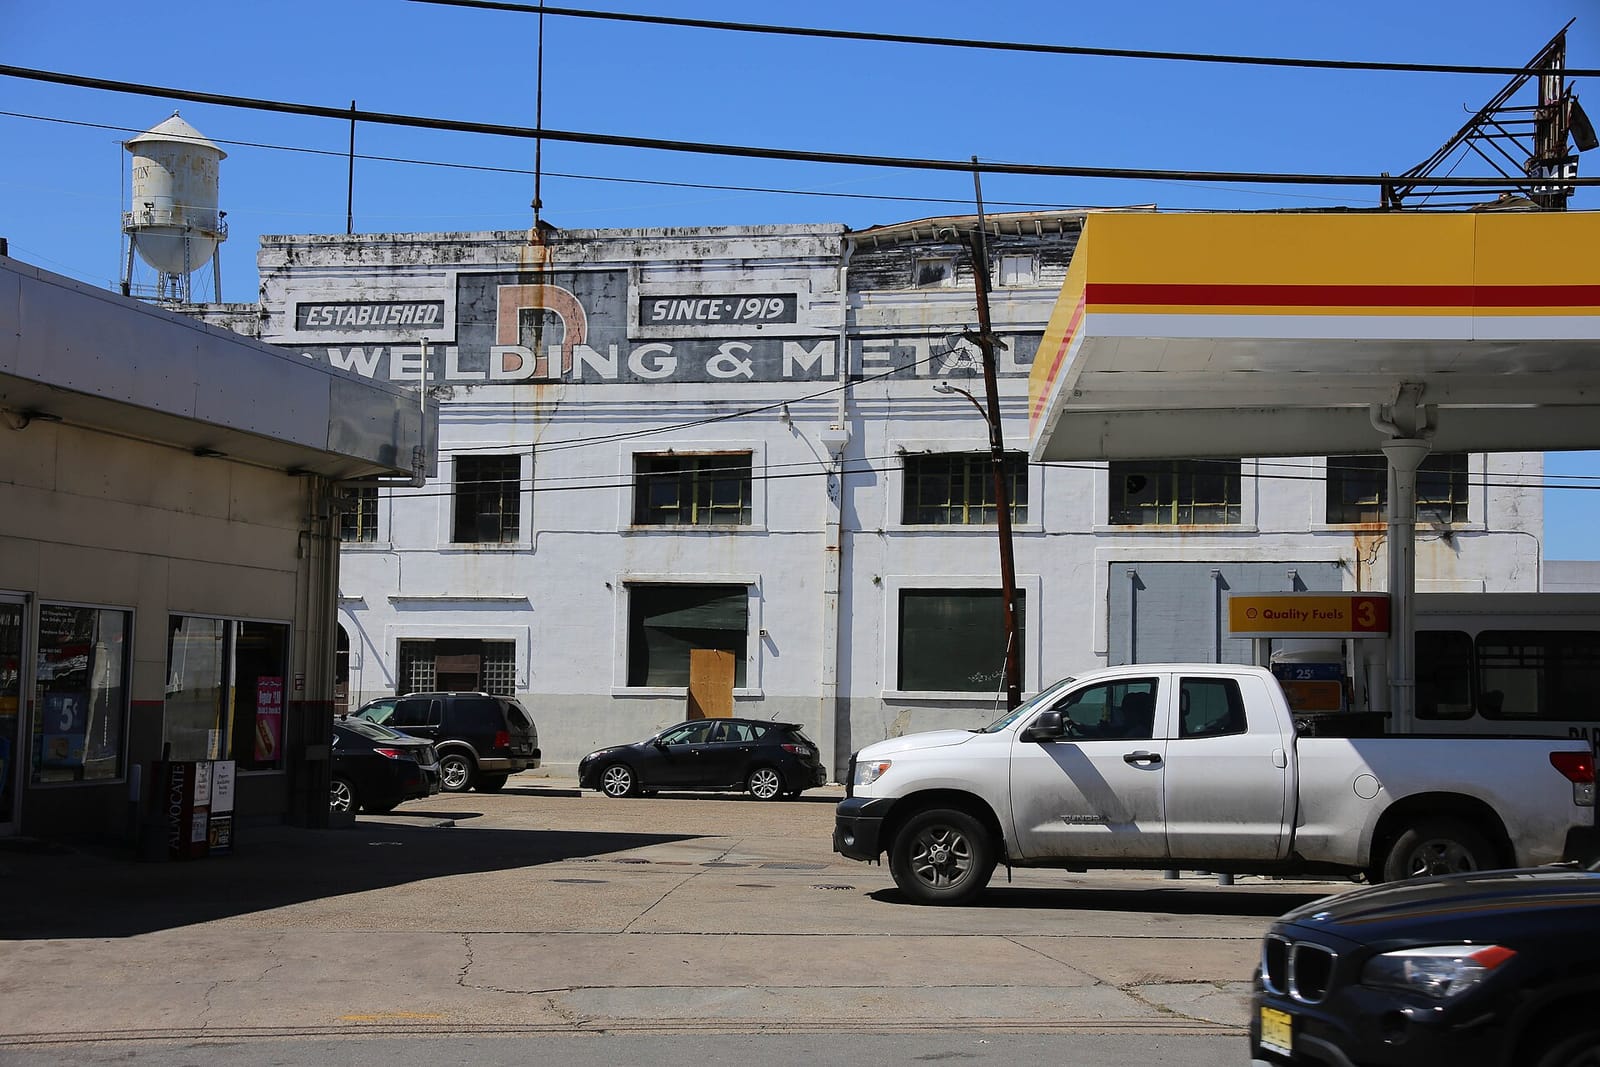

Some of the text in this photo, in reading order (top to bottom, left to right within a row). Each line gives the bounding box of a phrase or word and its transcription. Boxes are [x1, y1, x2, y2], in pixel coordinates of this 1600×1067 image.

[305, 303, 440, 326] ESTABLISHED
[651, 296, 786, 321] SINCE 1919
[496, 284, 588, 377] D
[327, 335, 1034, 381] WELDING & METAL
[1263, 608, 1344, 622] Quality Fuels
[1357, 600, 1377, 628] 3
